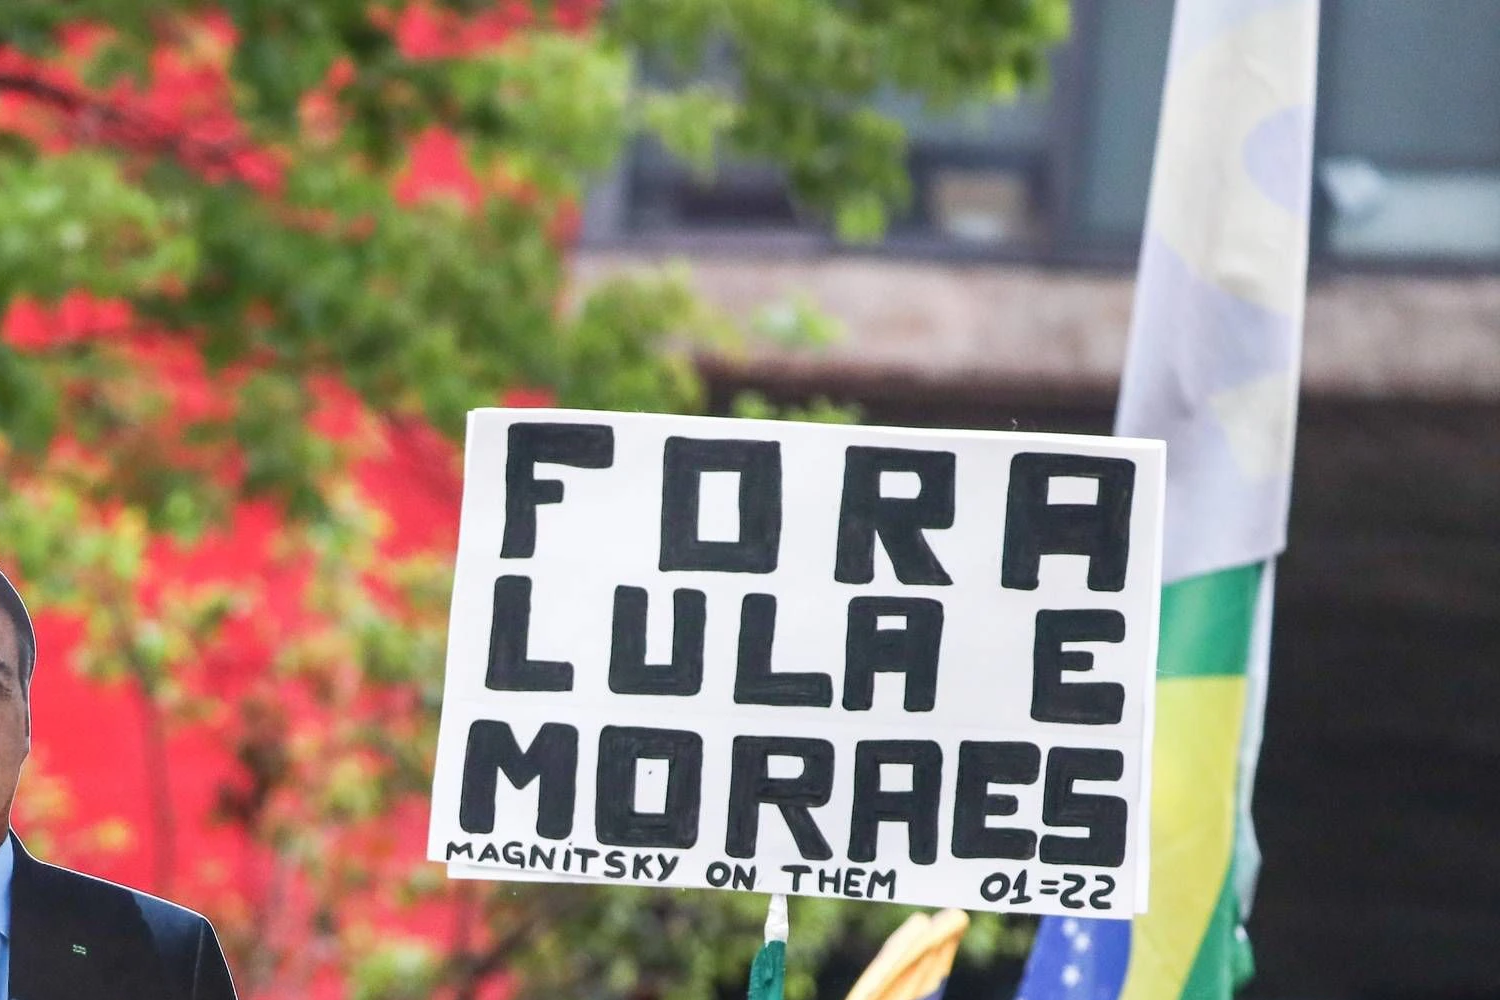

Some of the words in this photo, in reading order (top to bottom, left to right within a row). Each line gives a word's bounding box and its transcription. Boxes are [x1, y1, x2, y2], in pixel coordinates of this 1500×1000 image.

[500, 422, 1136, 592] FORA
[484, 575, 945, 713] LULA
[1030, 608, 1126, 726] E
[458, 719, 1129, 868] MORAES
[705, 861, 757, 891] ON
[779, 864, 898, 900] THEM
